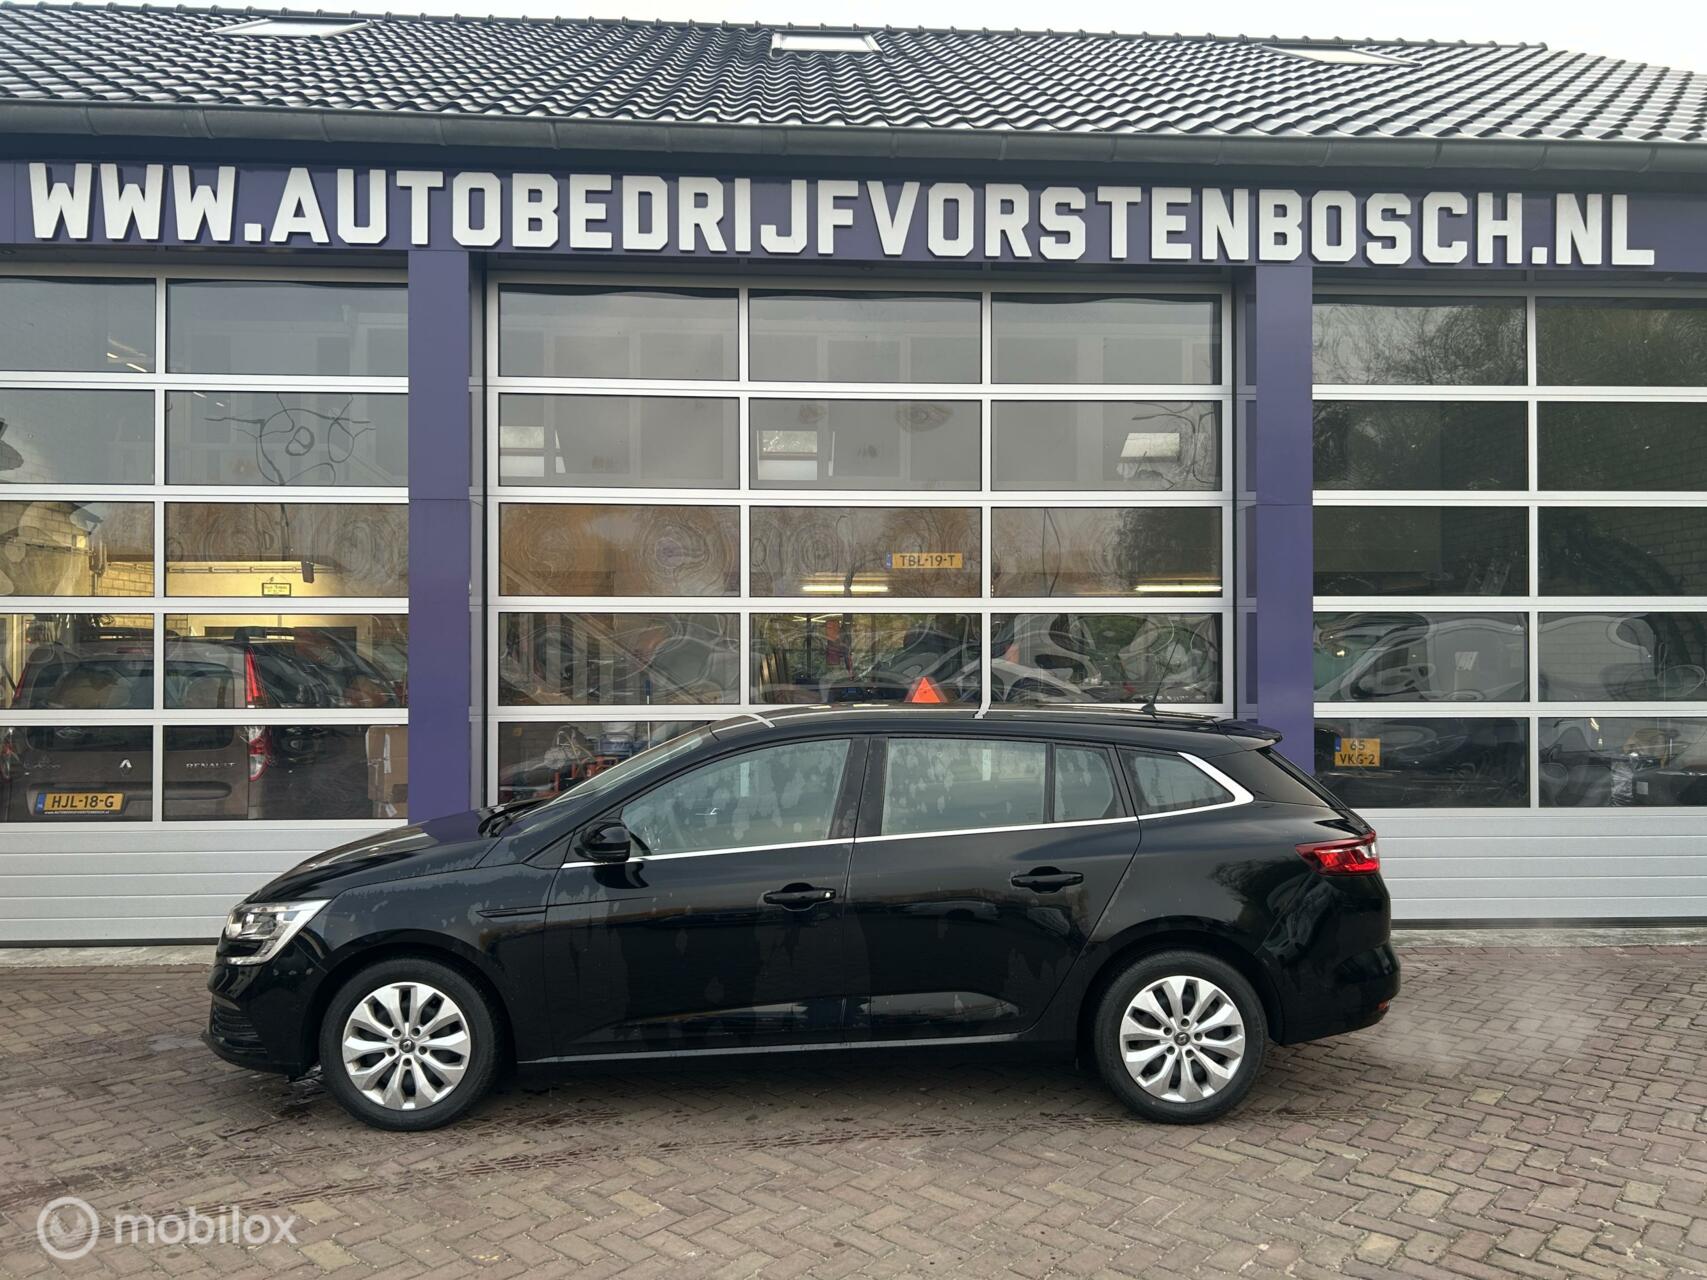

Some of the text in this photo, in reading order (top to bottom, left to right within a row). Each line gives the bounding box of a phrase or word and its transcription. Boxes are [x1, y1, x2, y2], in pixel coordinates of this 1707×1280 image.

[29, 162, 1656, 267] WWW.AUTOBEDRIJFVORSTENBOSCH.NL
[900, 555, 955, 567] TBL-19-T
[1350, 740, 1366, 750] 65
[1340, 753, 1376, 765] VKG-2
[51, 795, 115, 809] HJL-18-G
